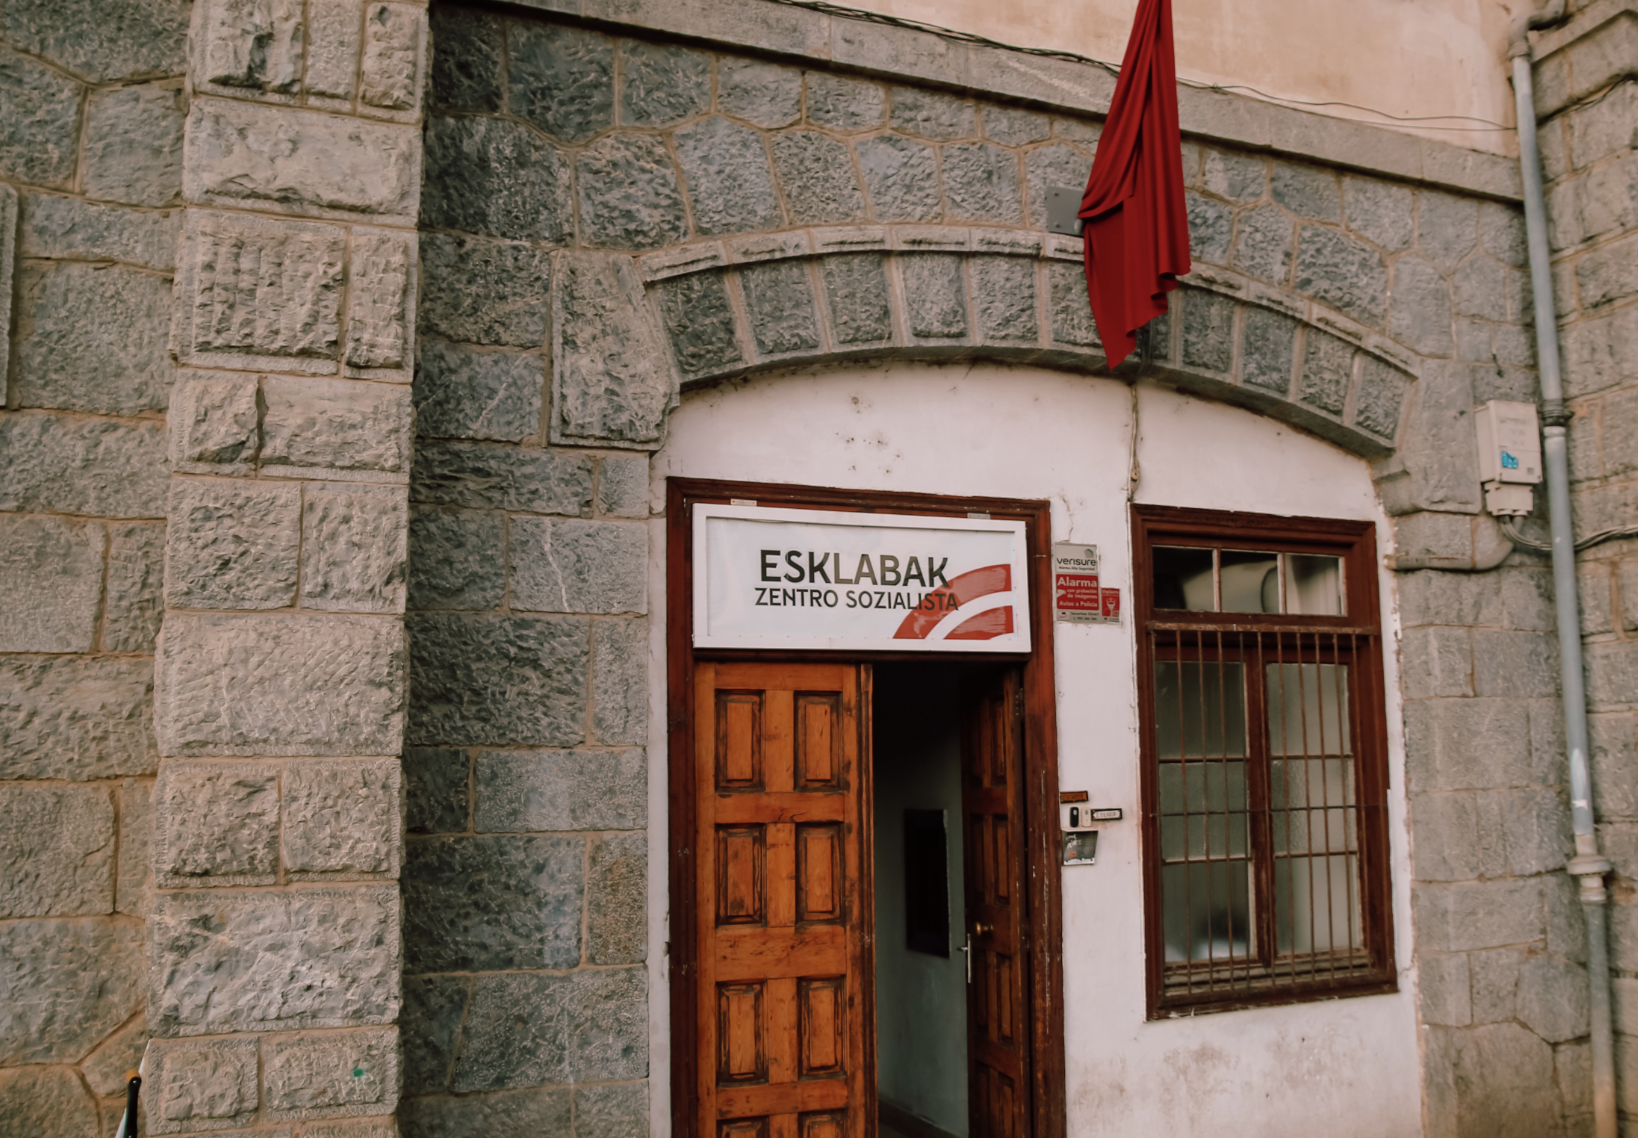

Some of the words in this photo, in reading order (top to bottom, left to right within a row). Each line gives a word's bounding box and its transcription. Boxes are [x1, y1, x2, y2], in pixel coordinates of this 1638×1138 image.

[760, 549, 950, 588] ESKLABAK
[1057, 576, 1097, 588] Alarma
[754, 587, 839, 608] ZENTRO
[845, 590, 959, 611] SOZIALISTA
